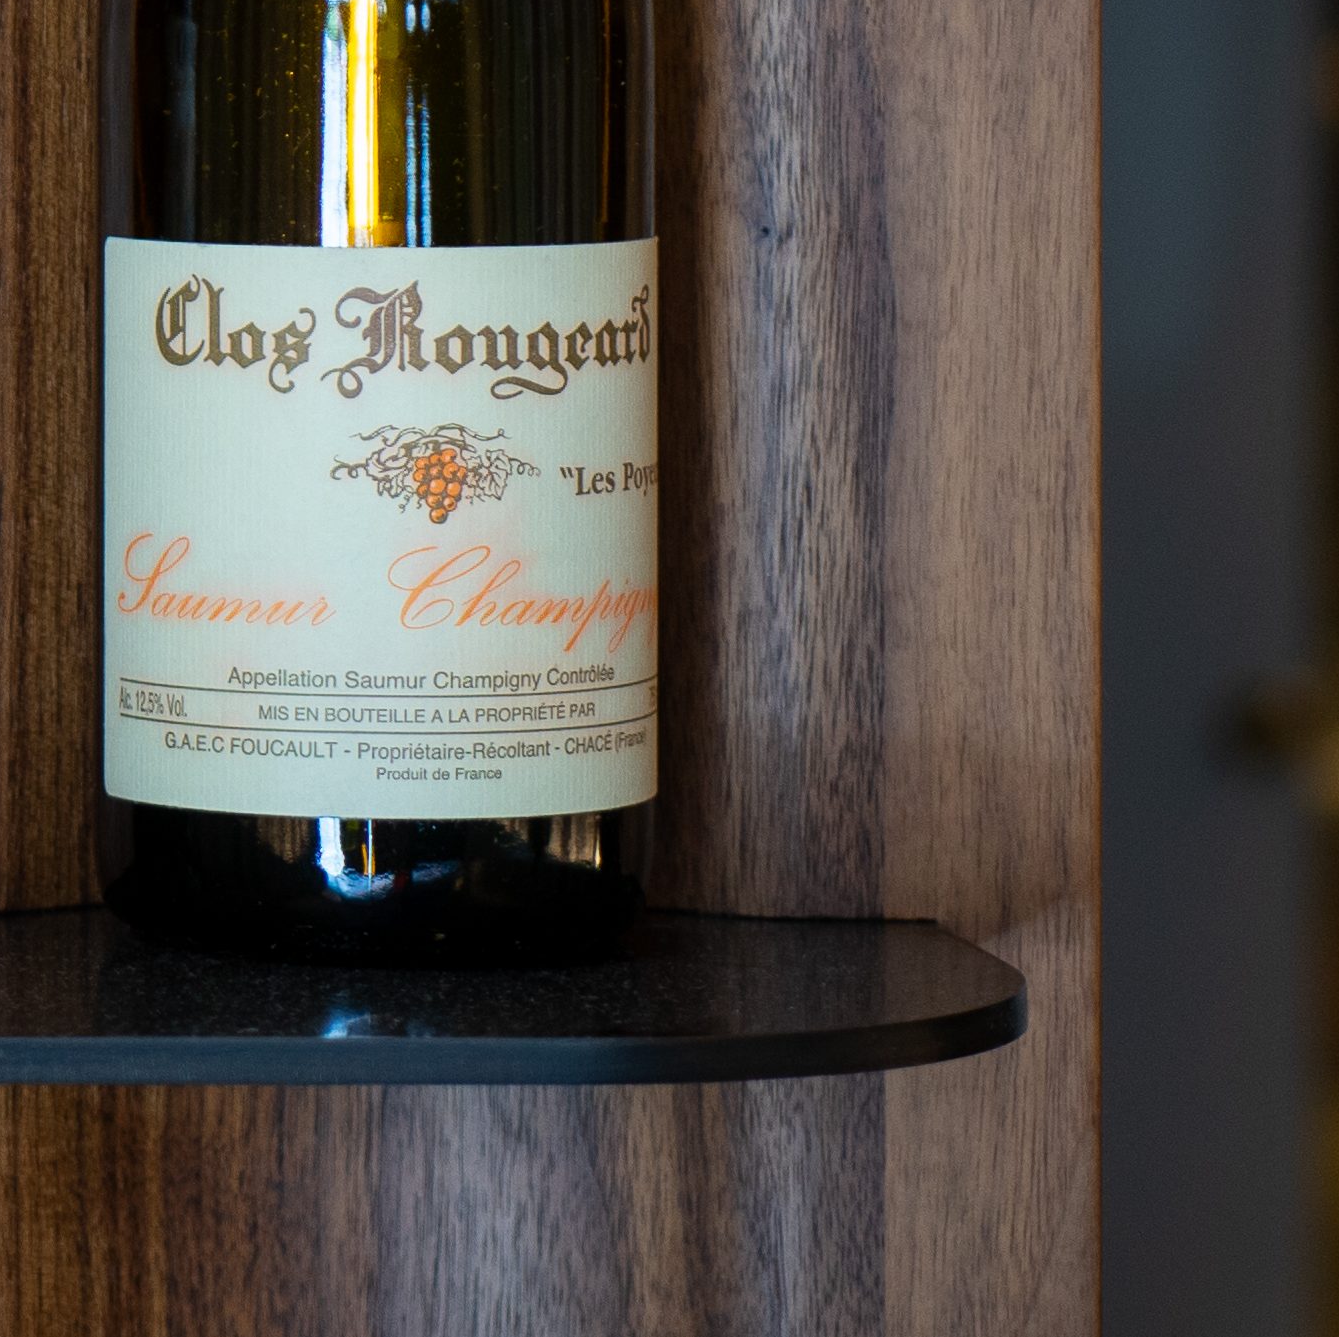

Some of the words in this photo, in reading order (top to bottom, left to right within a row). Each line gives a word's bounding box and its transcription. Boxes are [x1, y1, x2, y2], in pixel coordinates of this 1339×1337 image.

[155, 273, 316, 394] Clos
[321, 279, 650, 400] Rougeard
[118, 533, 337, 626] Saumur
[387, 545, 657, 653] Champign
[228, 666, 336, 689] Appellation
[345, 670, 426, 689] Saumur
[433, 671, 541, 692] Champigny
[547, 664, 614, 686] Contrôlée
[167, 694, 187, 717] Vol.
[258, 705, 288, 721] MIS
[295, 707, 318, 721] EN
[325, 707, 425, 723] BOUTEILLE
[431, 709, 442, 723] A
[449, 708, 470, 723] LA
[475, 701, 565, 722] PROPRIÉTÉ
[569, 702, 595, 717] PAR
[230, 738, 337, 758] FOUCAULT
[564, 730, 612, 754] CHACÉ
[377, 767, 427, 781] Produit
[432, 768, 450, 780] de
[455, 768, 502, 780] France
